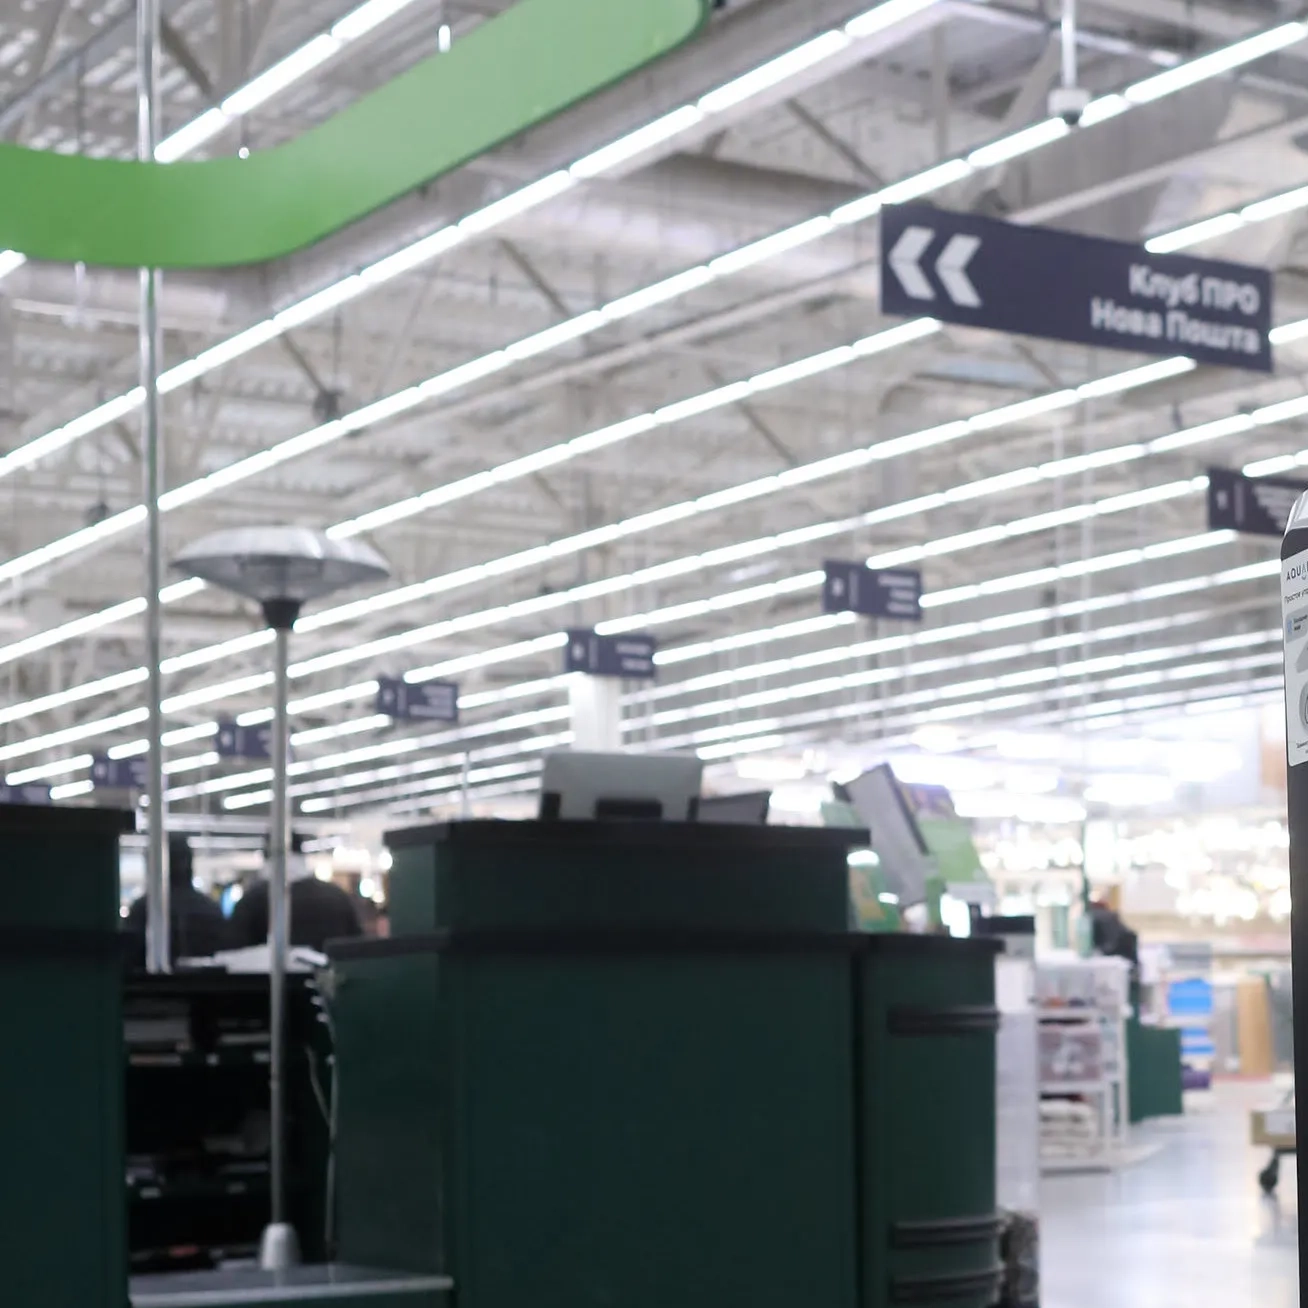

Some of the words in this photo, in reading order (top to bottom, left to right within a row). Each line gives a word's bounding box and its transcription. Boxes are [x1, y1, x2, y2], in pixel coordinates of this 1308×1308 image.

[1129, 263, 1200, 308] Клуб
[1201, 276, 1261, 315] ПРО
[1090, 296, 1163, 339] Нова
[1165, 309, 1260, 354] Пошта
